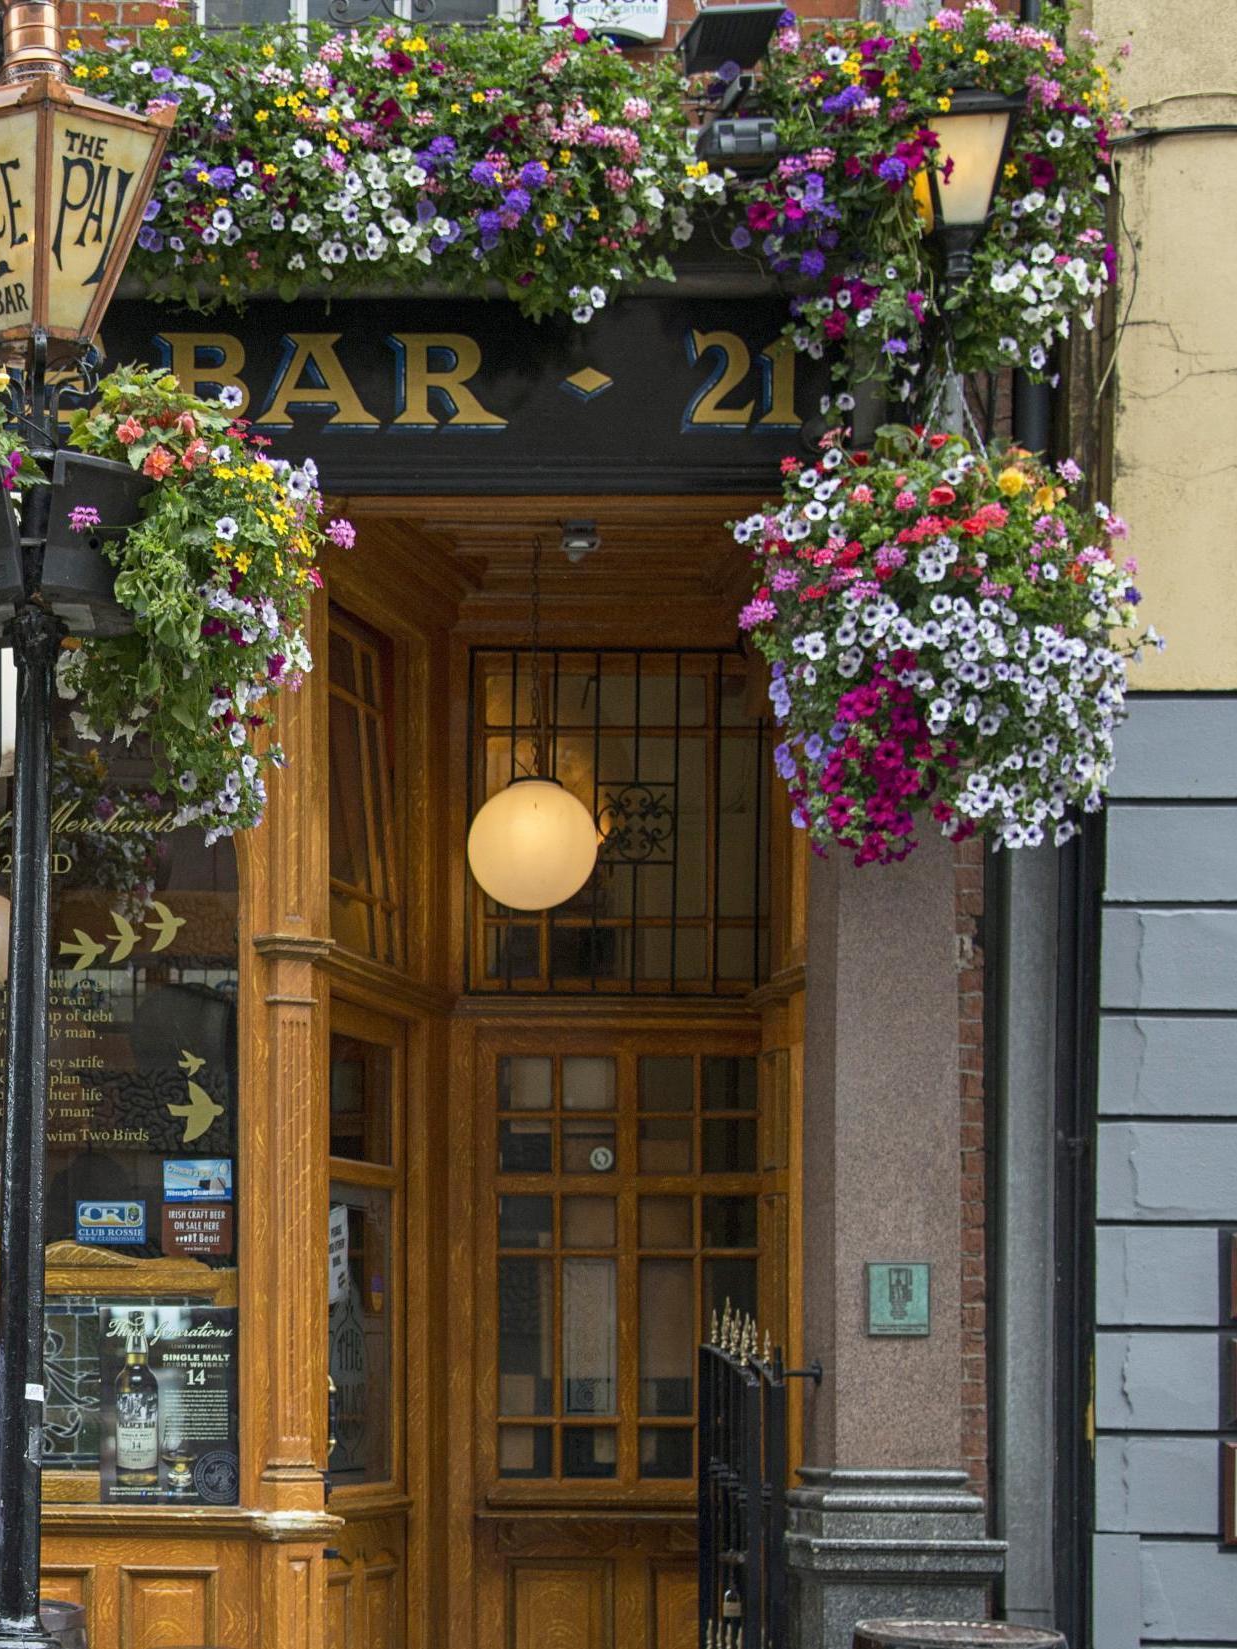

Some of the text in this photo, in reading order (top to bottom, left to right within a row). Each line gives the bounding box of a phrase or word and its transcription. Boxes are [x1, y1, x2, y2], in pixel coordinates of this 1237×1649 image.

[66, 129, 108, 161] THE
[155, 331, 509, 429] BAR
[684, 327, 803, 430] 21
[63, 995, 86, 1005] ran
[66, 1009, 80, 1022] of
[83, 1009, 113, 1023] debt
[68, 1055, 105, 1068] strife
[50, 1071, 81, 1087] plan
[81, 1087, 103, 1101] life
[79, 1128, 110, 1142] Two
[113, 1127, 150, 1142] Birds
[168, 1210, 225, 1219] IRISH CRAFT BEER
[78, 1228, 105, 1236] CLUB
[174, 1221, 219, 1230] ON SALE HERE
[150, 1320, 234, 1346] Generations
[162, 1353, 231, 1361] SINGLE MALT
[186, 1369, 206, 1386] 14
